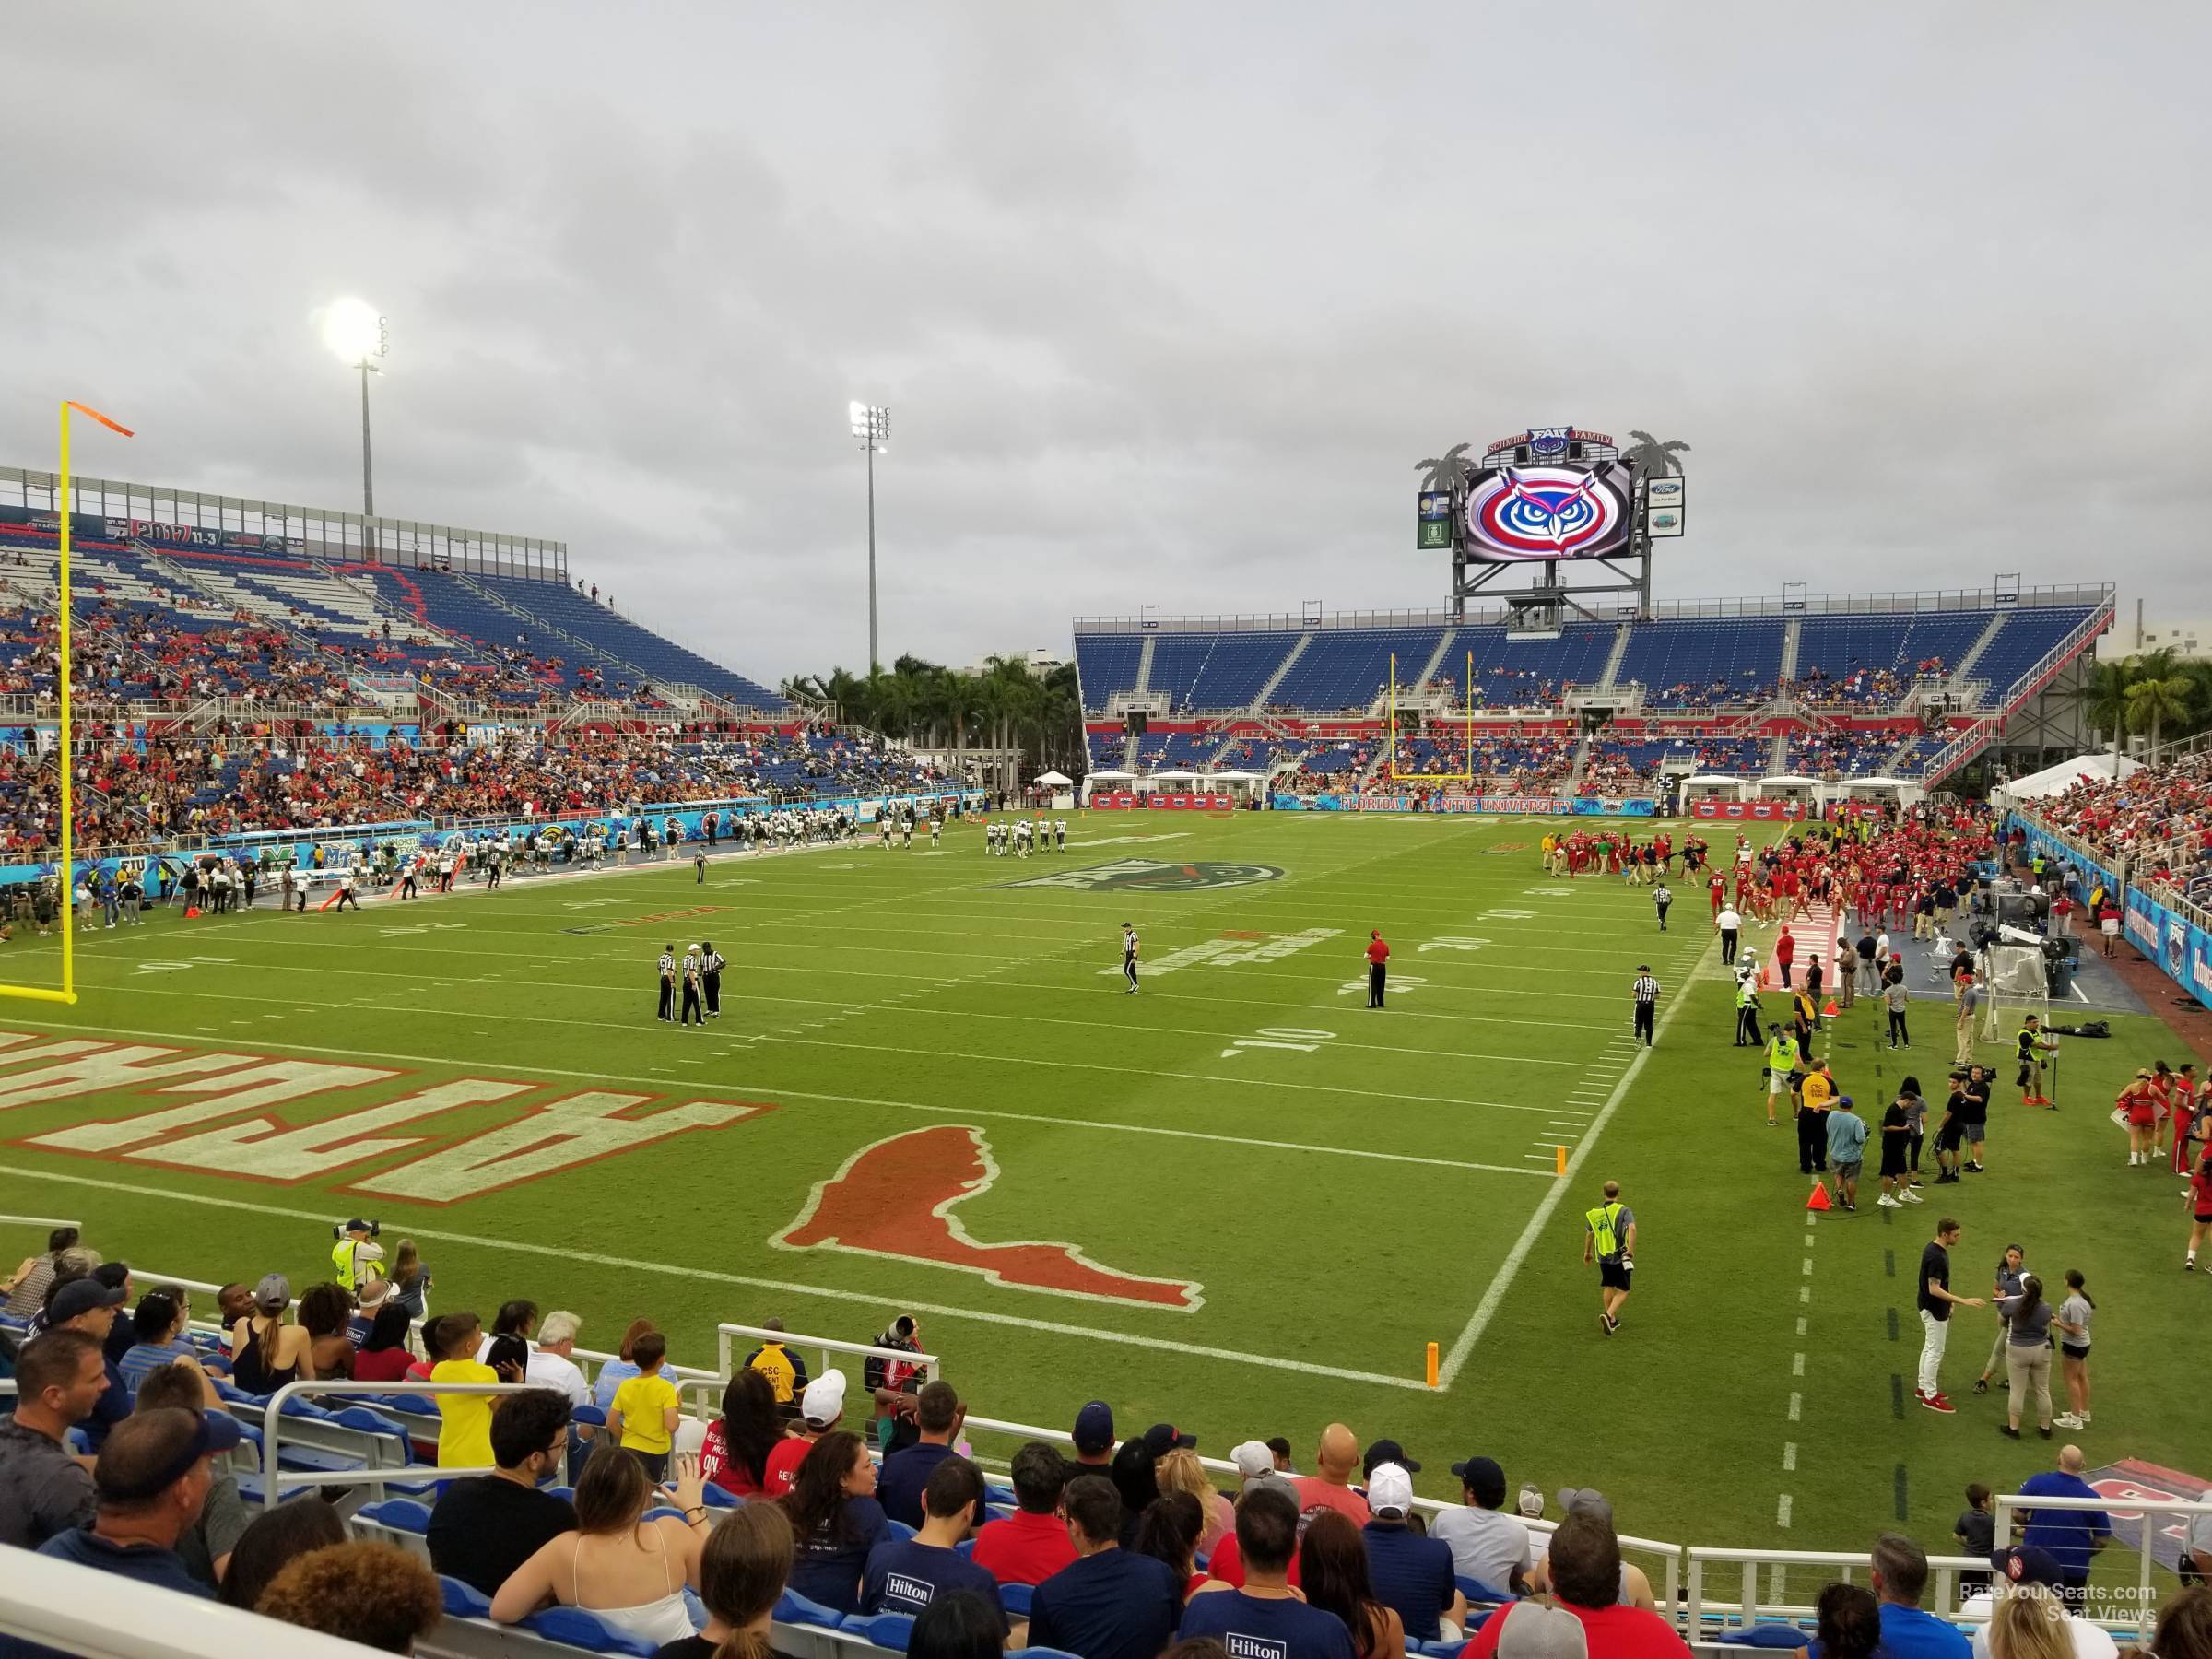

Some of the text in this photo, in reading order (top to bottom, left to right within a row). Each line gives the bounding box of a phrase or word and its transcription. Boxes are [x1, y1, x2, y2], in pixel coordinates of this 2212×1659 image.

[1532, 429, 1566, 441] FAU
[1575, 429, 1611, 444] FAMILY
[1488, 435, 1527, 452] SCHMIDT
[1655, 484, 1676, 493] Ford
[138, 522, 185, 543] 2017
[193, 532, 217, 546] 11-3
[1657, 776, 1673, 788] 25
[1341, 795, 1399, 810] FLORIDA
[1480, 797, 1575, 814] UNIVERSITY
[1643, 982, 1653, 994] H
[1234, 1027, 1338, 1052] 10
[346, 1329, 361, 1341] ilton
[761, 1366, 780, 1375] CSC
[889, 1577, 928, 1602] Hilton
[1230, 1638, 1281, 1659] Hilton
